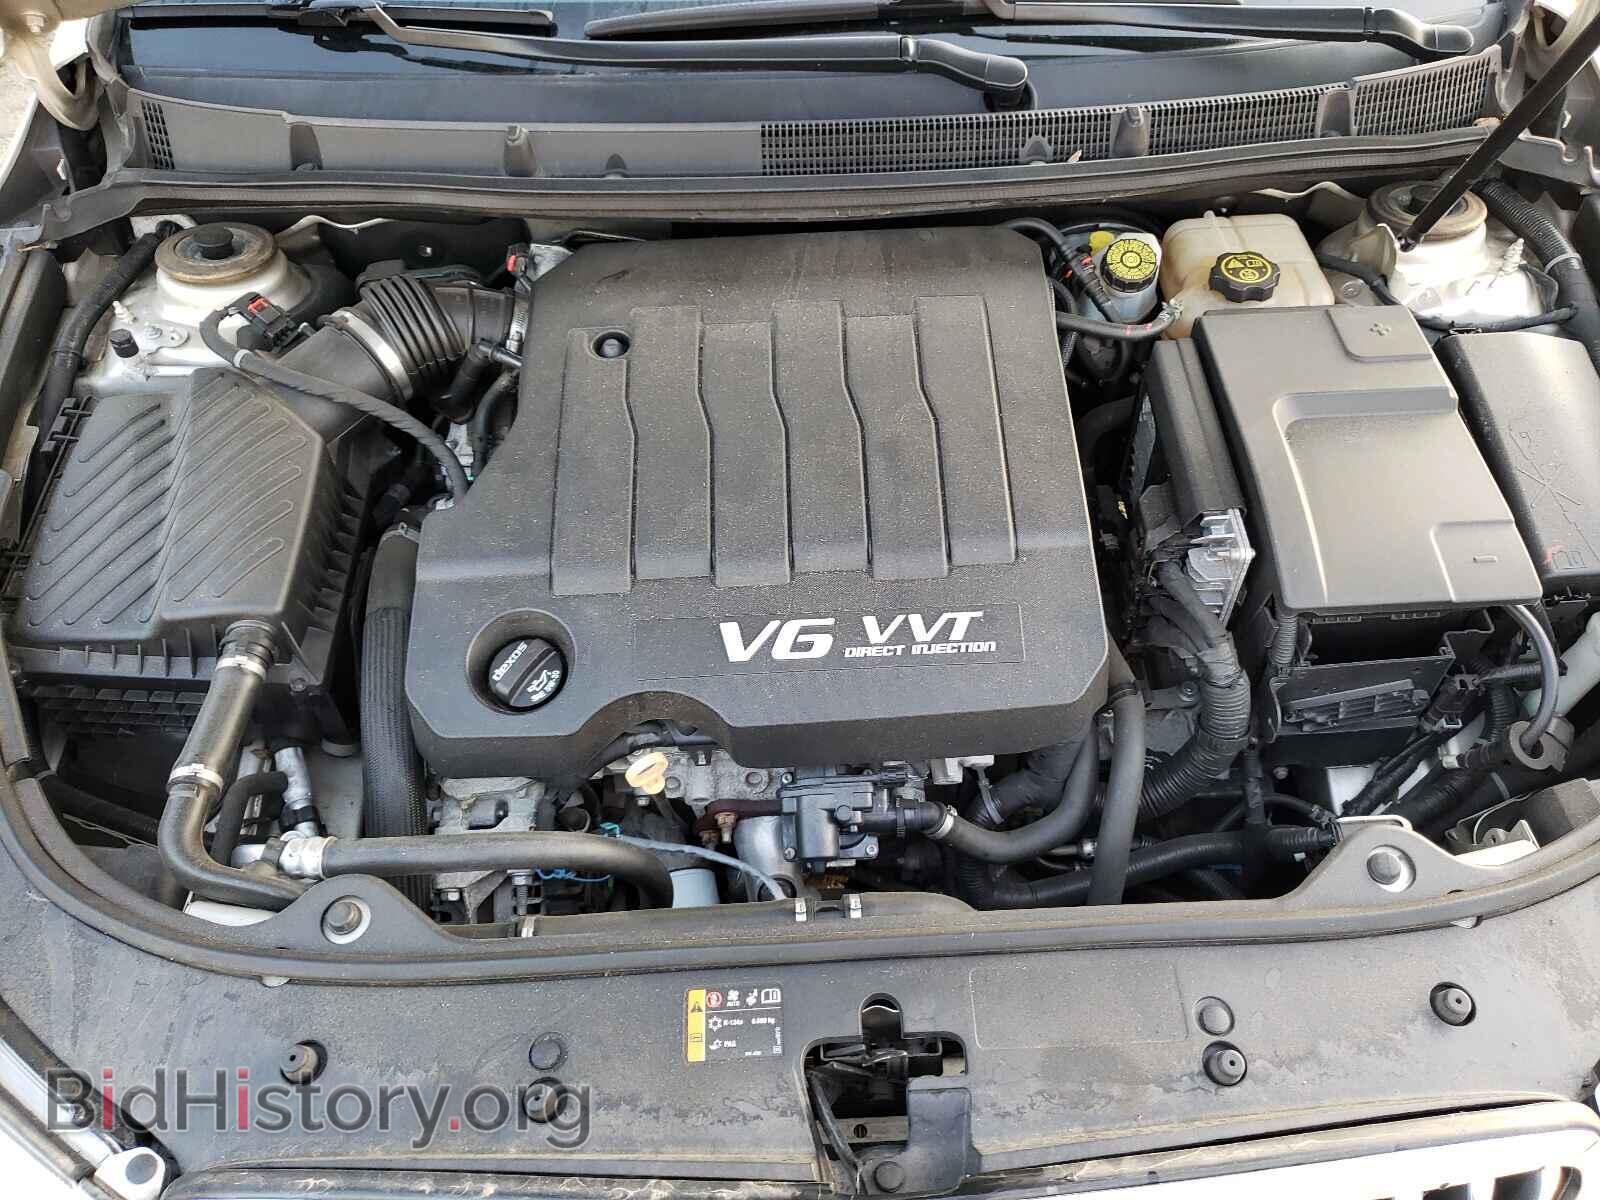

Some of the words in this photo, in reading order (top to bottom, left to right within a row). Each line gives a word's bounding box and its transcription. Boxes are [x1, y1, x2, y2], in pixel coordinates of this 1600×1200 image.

[719, 617, 836, 662] V6
[862, 610, 985, 645] VVT
[843, 644, 906, 658] DIRECT
[911, 641, 997, 655] INJECTION
[491, 641, 528, 681] dexos
